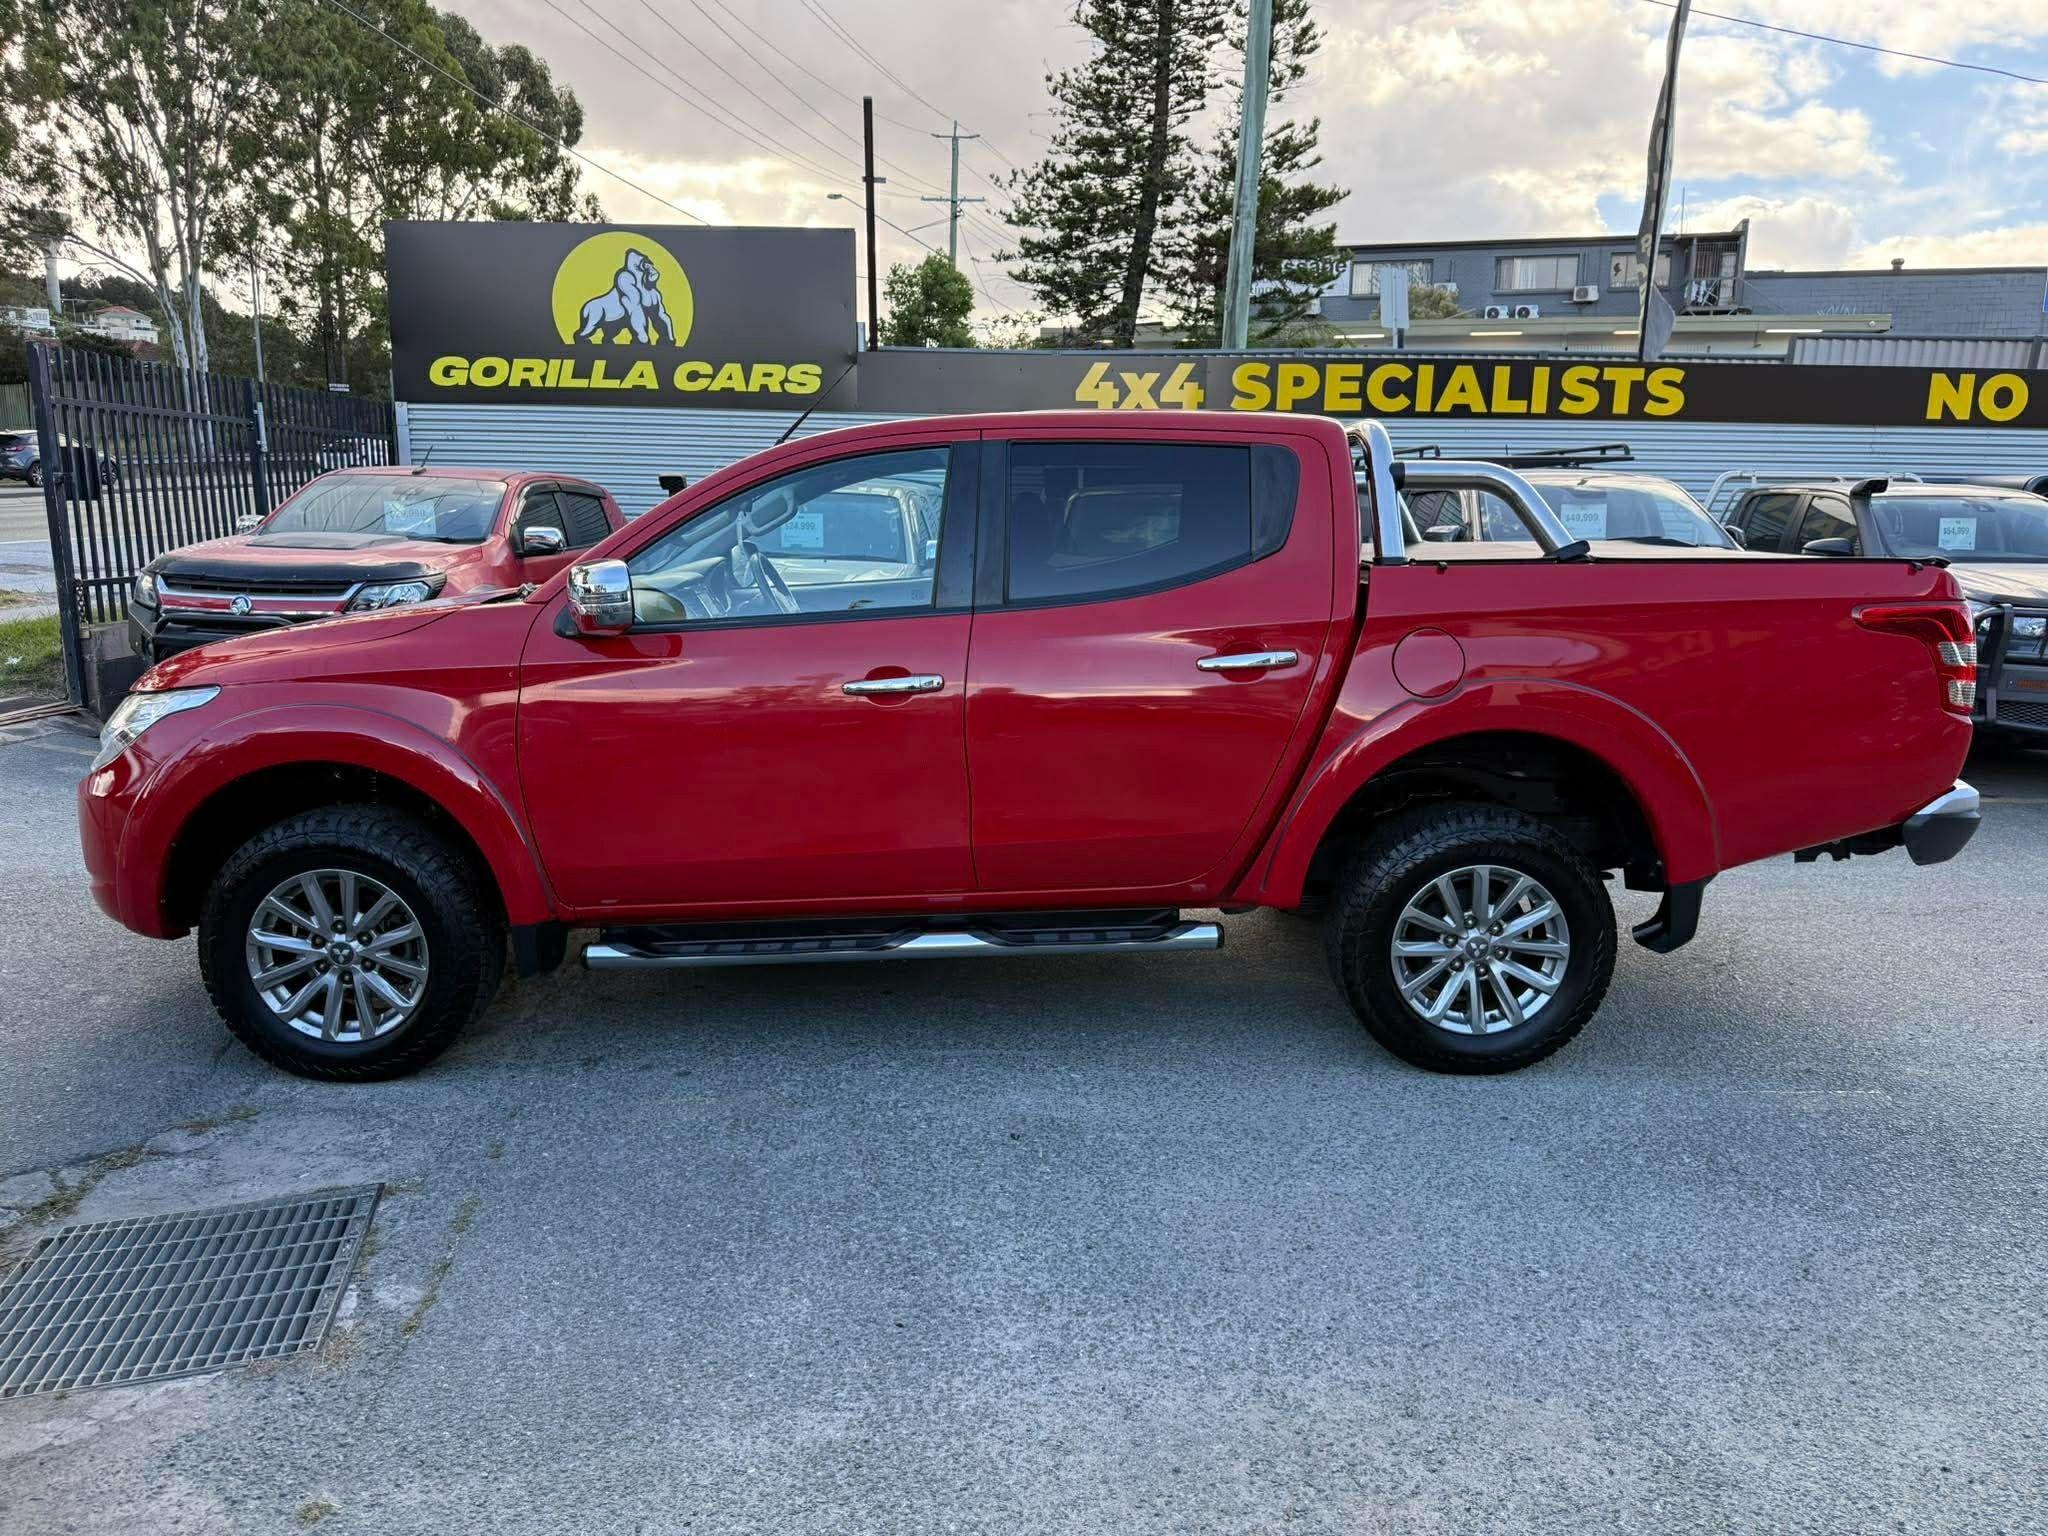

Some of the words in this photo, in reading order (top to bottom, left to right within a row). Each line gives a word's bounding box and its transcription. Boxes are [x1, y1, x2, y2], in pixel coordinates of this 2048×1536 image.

[429, 356, 660, 390] GORILLA
[673, 360, 823, 394] CARS
[1074, 362, 1205, 411] 4x4
[1231, 362, 1686, 416] SPECIALISTS
[1925, 373, 2029, 422] NO
